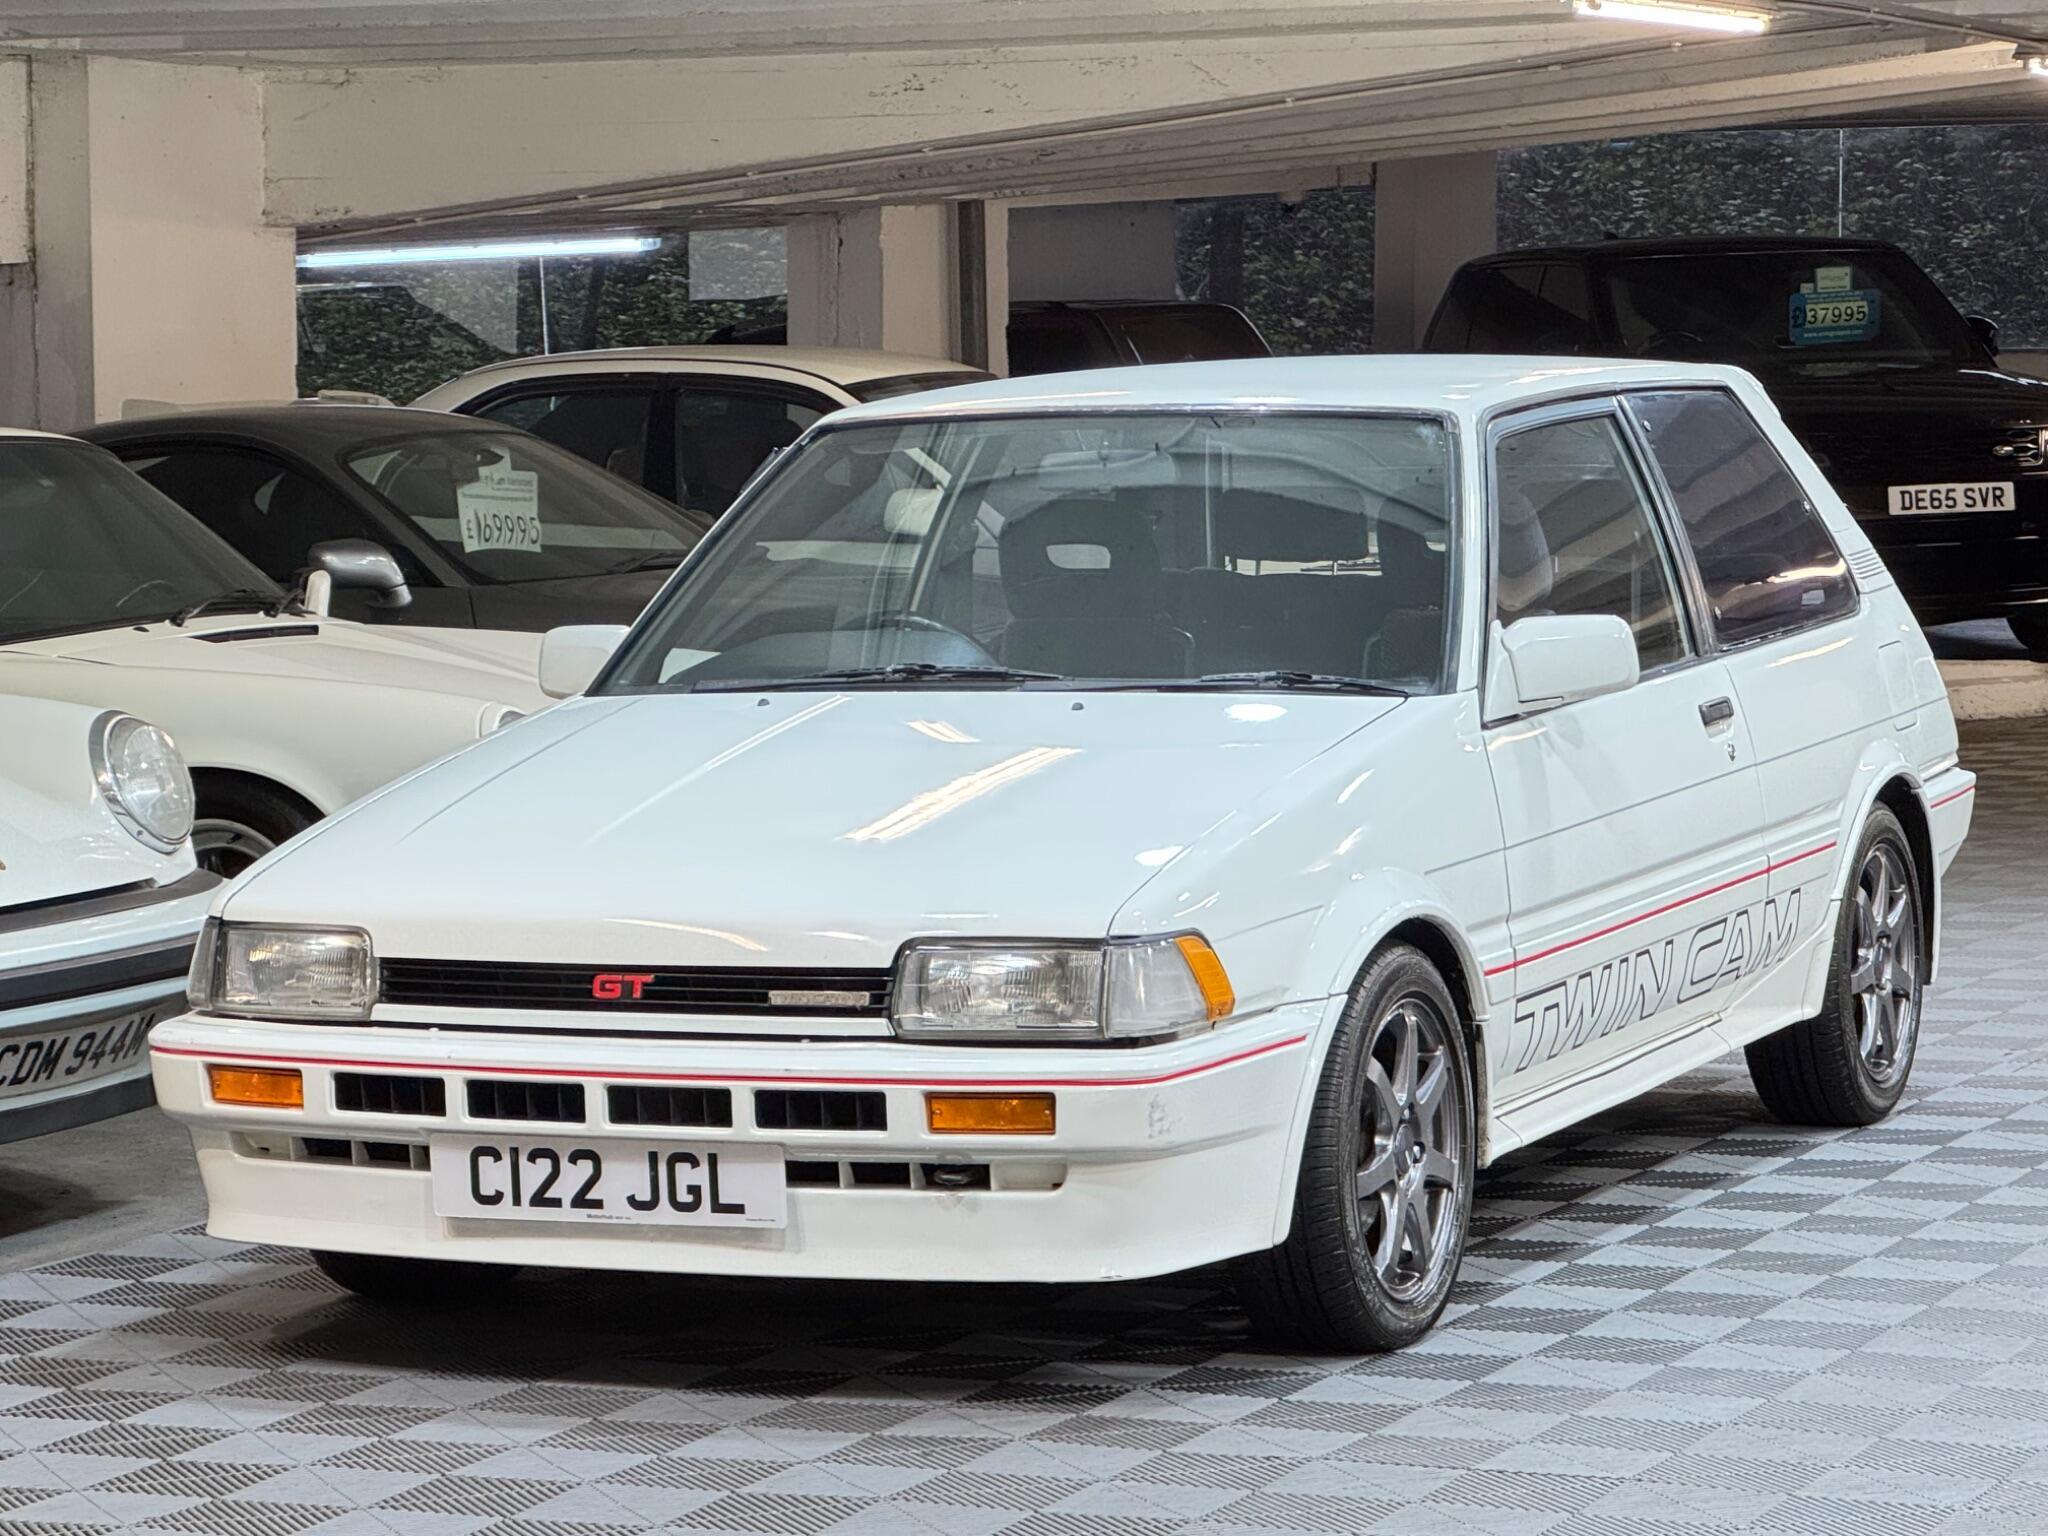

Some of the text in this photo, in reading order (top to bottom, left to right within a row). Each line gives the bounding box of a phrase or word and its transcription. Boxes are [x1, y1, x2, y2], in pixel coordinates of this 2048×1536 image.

[1900, 485, 2005, 511] DE65 SVR
[591, 973, 655, 999] GT
[1514, 887, 1801, 1074] TWIN CAM
[0, 1035, 70, 1087] CDM
[469, 1145, 746, 1215] C122 JGL
